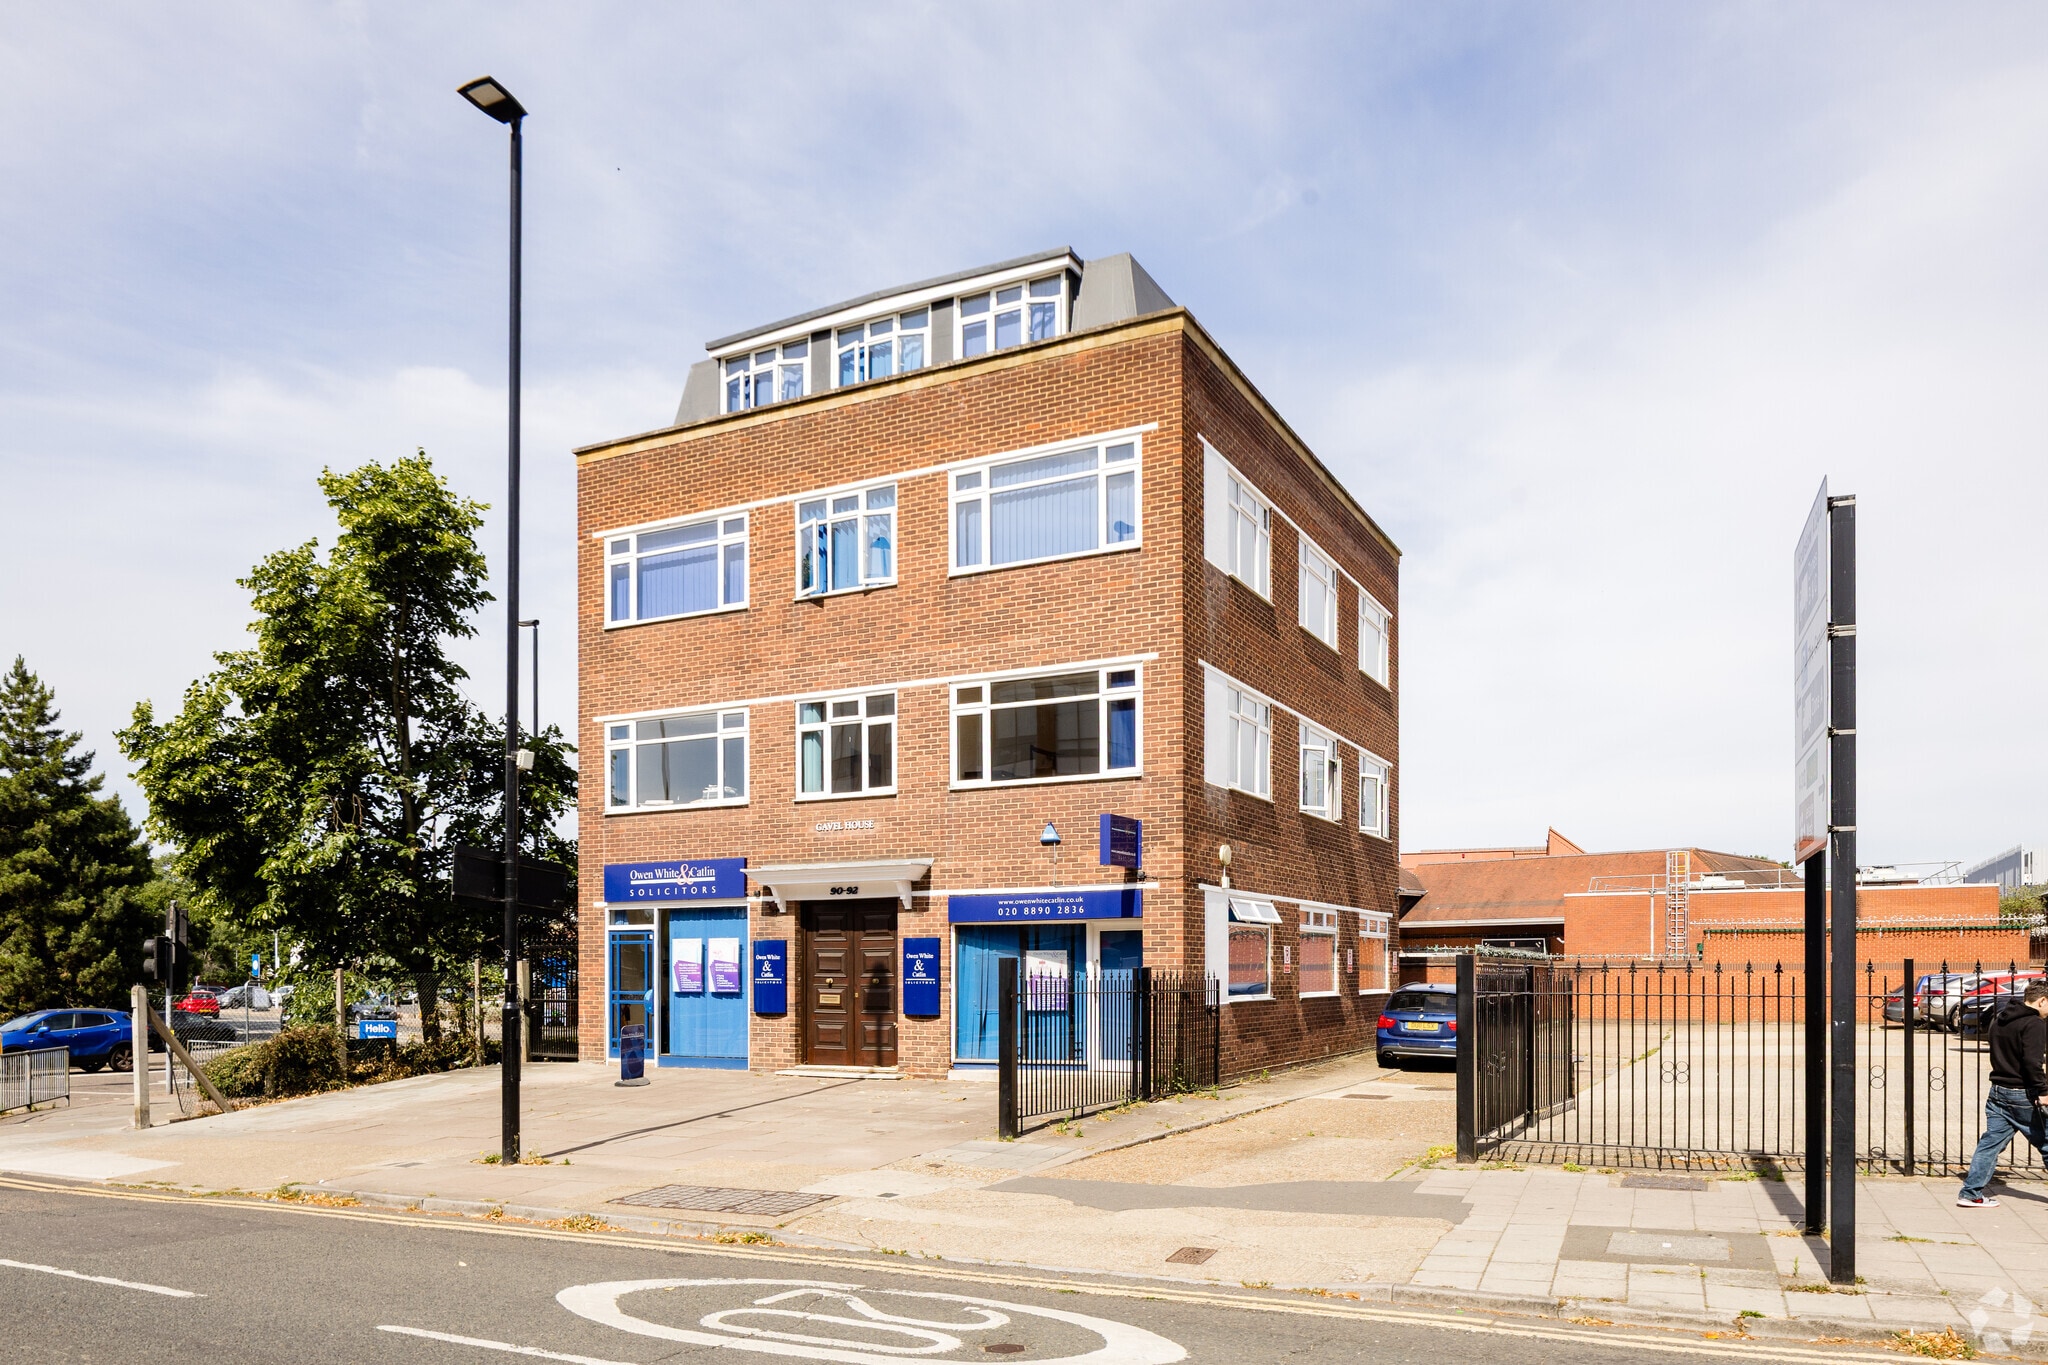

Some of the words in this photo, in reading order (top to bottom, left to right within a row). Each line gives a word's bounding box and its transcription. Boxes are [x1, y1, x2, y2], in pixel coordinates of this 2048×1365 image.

[816, 822, 843, 832] GAVEL
[845, 820, 875, 830] HOUSE
[630, 870, 653, 880] Owen
[655, 867, 679, 879] White
[691, 866, 715, 877] Catlin
[629, 886, 717, 897] SOLICITORS
[830, 886, 858, 895] 90-92
[998, 896, 1084, 905] www.owenwhitecatlin.co.uk
[998, 907, 1017, 916] 020
[1023, 906, 1051, 915] 8890
[1057, 905, 1084, 914] 2836
[762, 960, 772, 971] &
[914, 959, 925, 971] &
